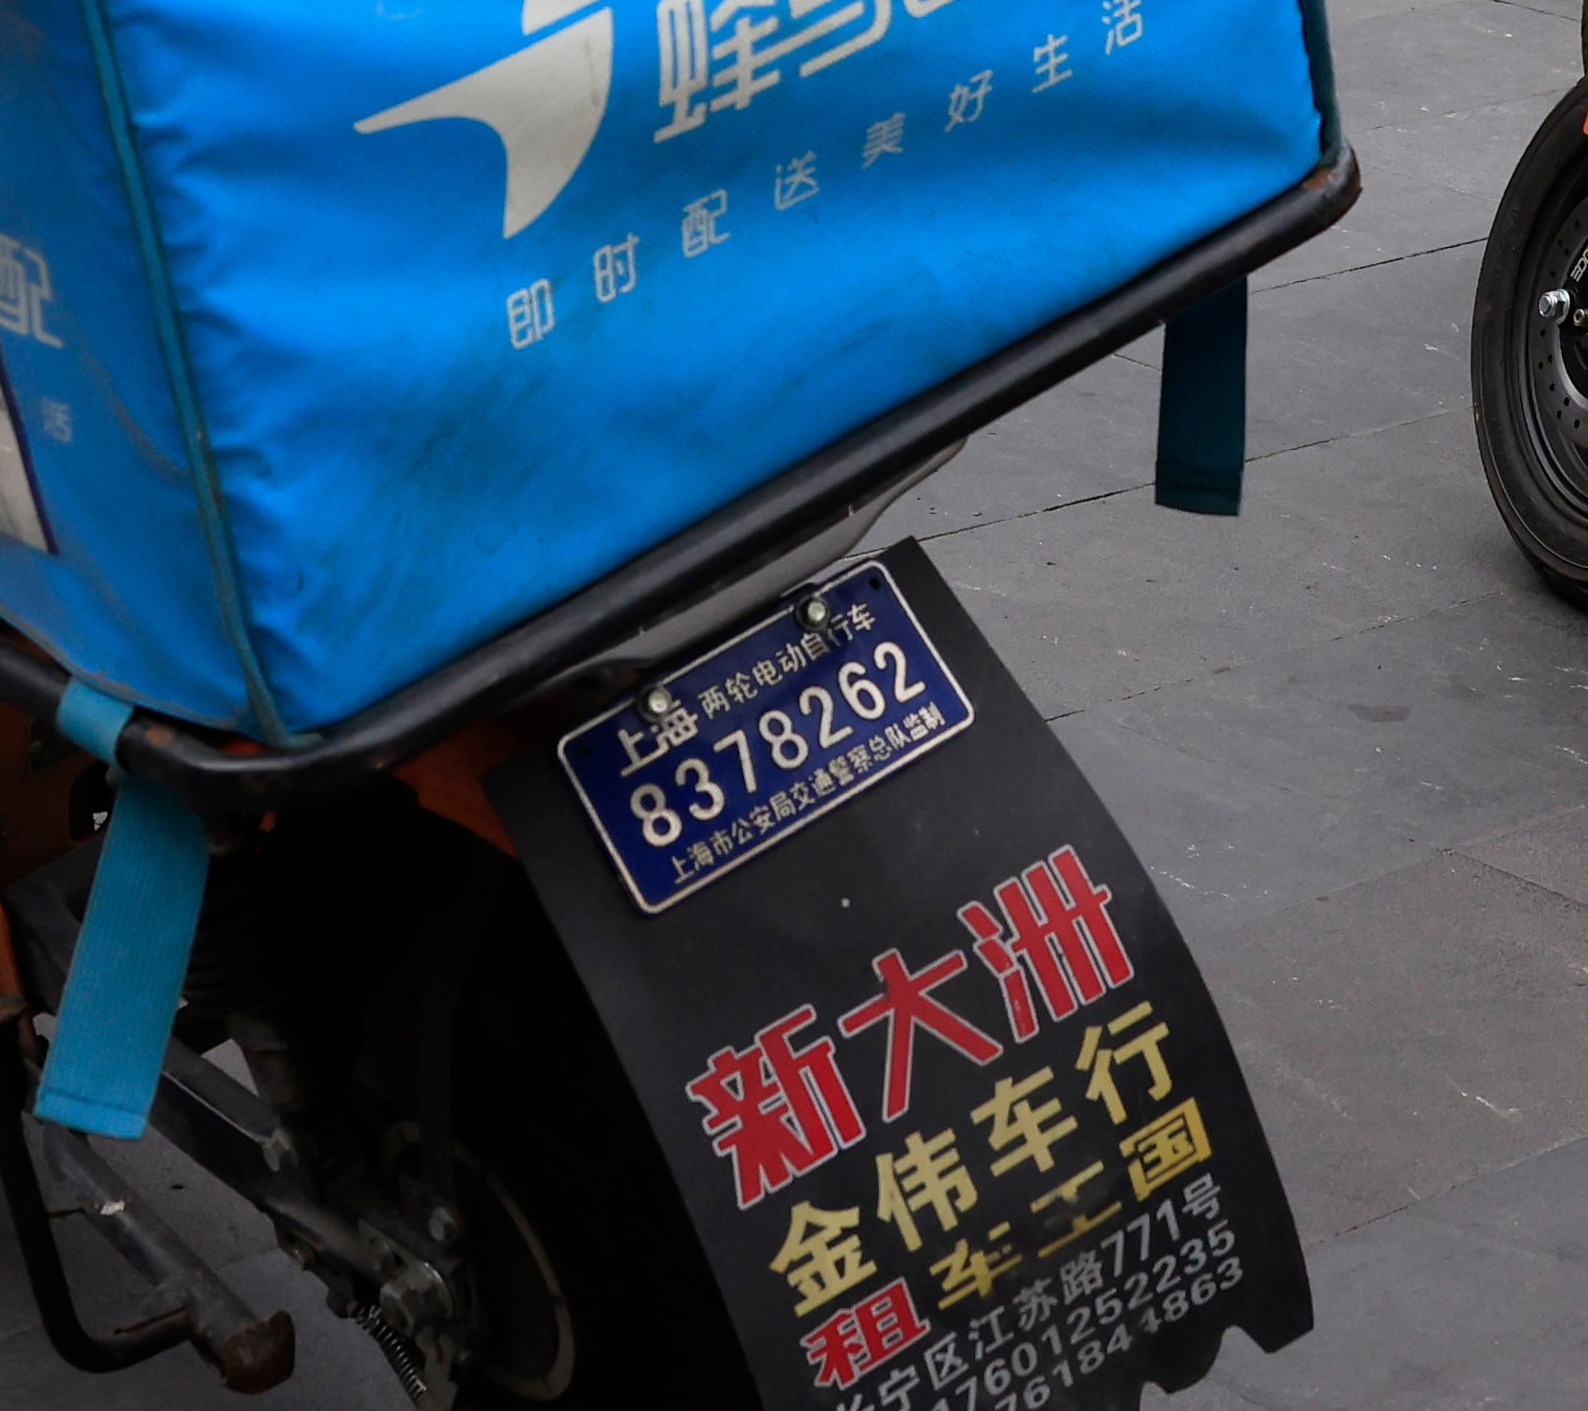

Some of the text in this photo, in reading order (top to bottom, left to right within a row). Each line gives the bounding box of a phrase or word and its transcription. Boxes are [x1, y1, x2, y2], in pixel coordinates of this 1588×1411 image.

[618, 602, 877, 777] 上海 两轮电动自行车
[629, 640, 926, 847] 8378262
[670, 702, 946, 884] 上海市公安局交通警察总队监制
[685, 843, 1135, 1210] 新大洲
[769, 1001, 1173, 1318] 金伟车行
